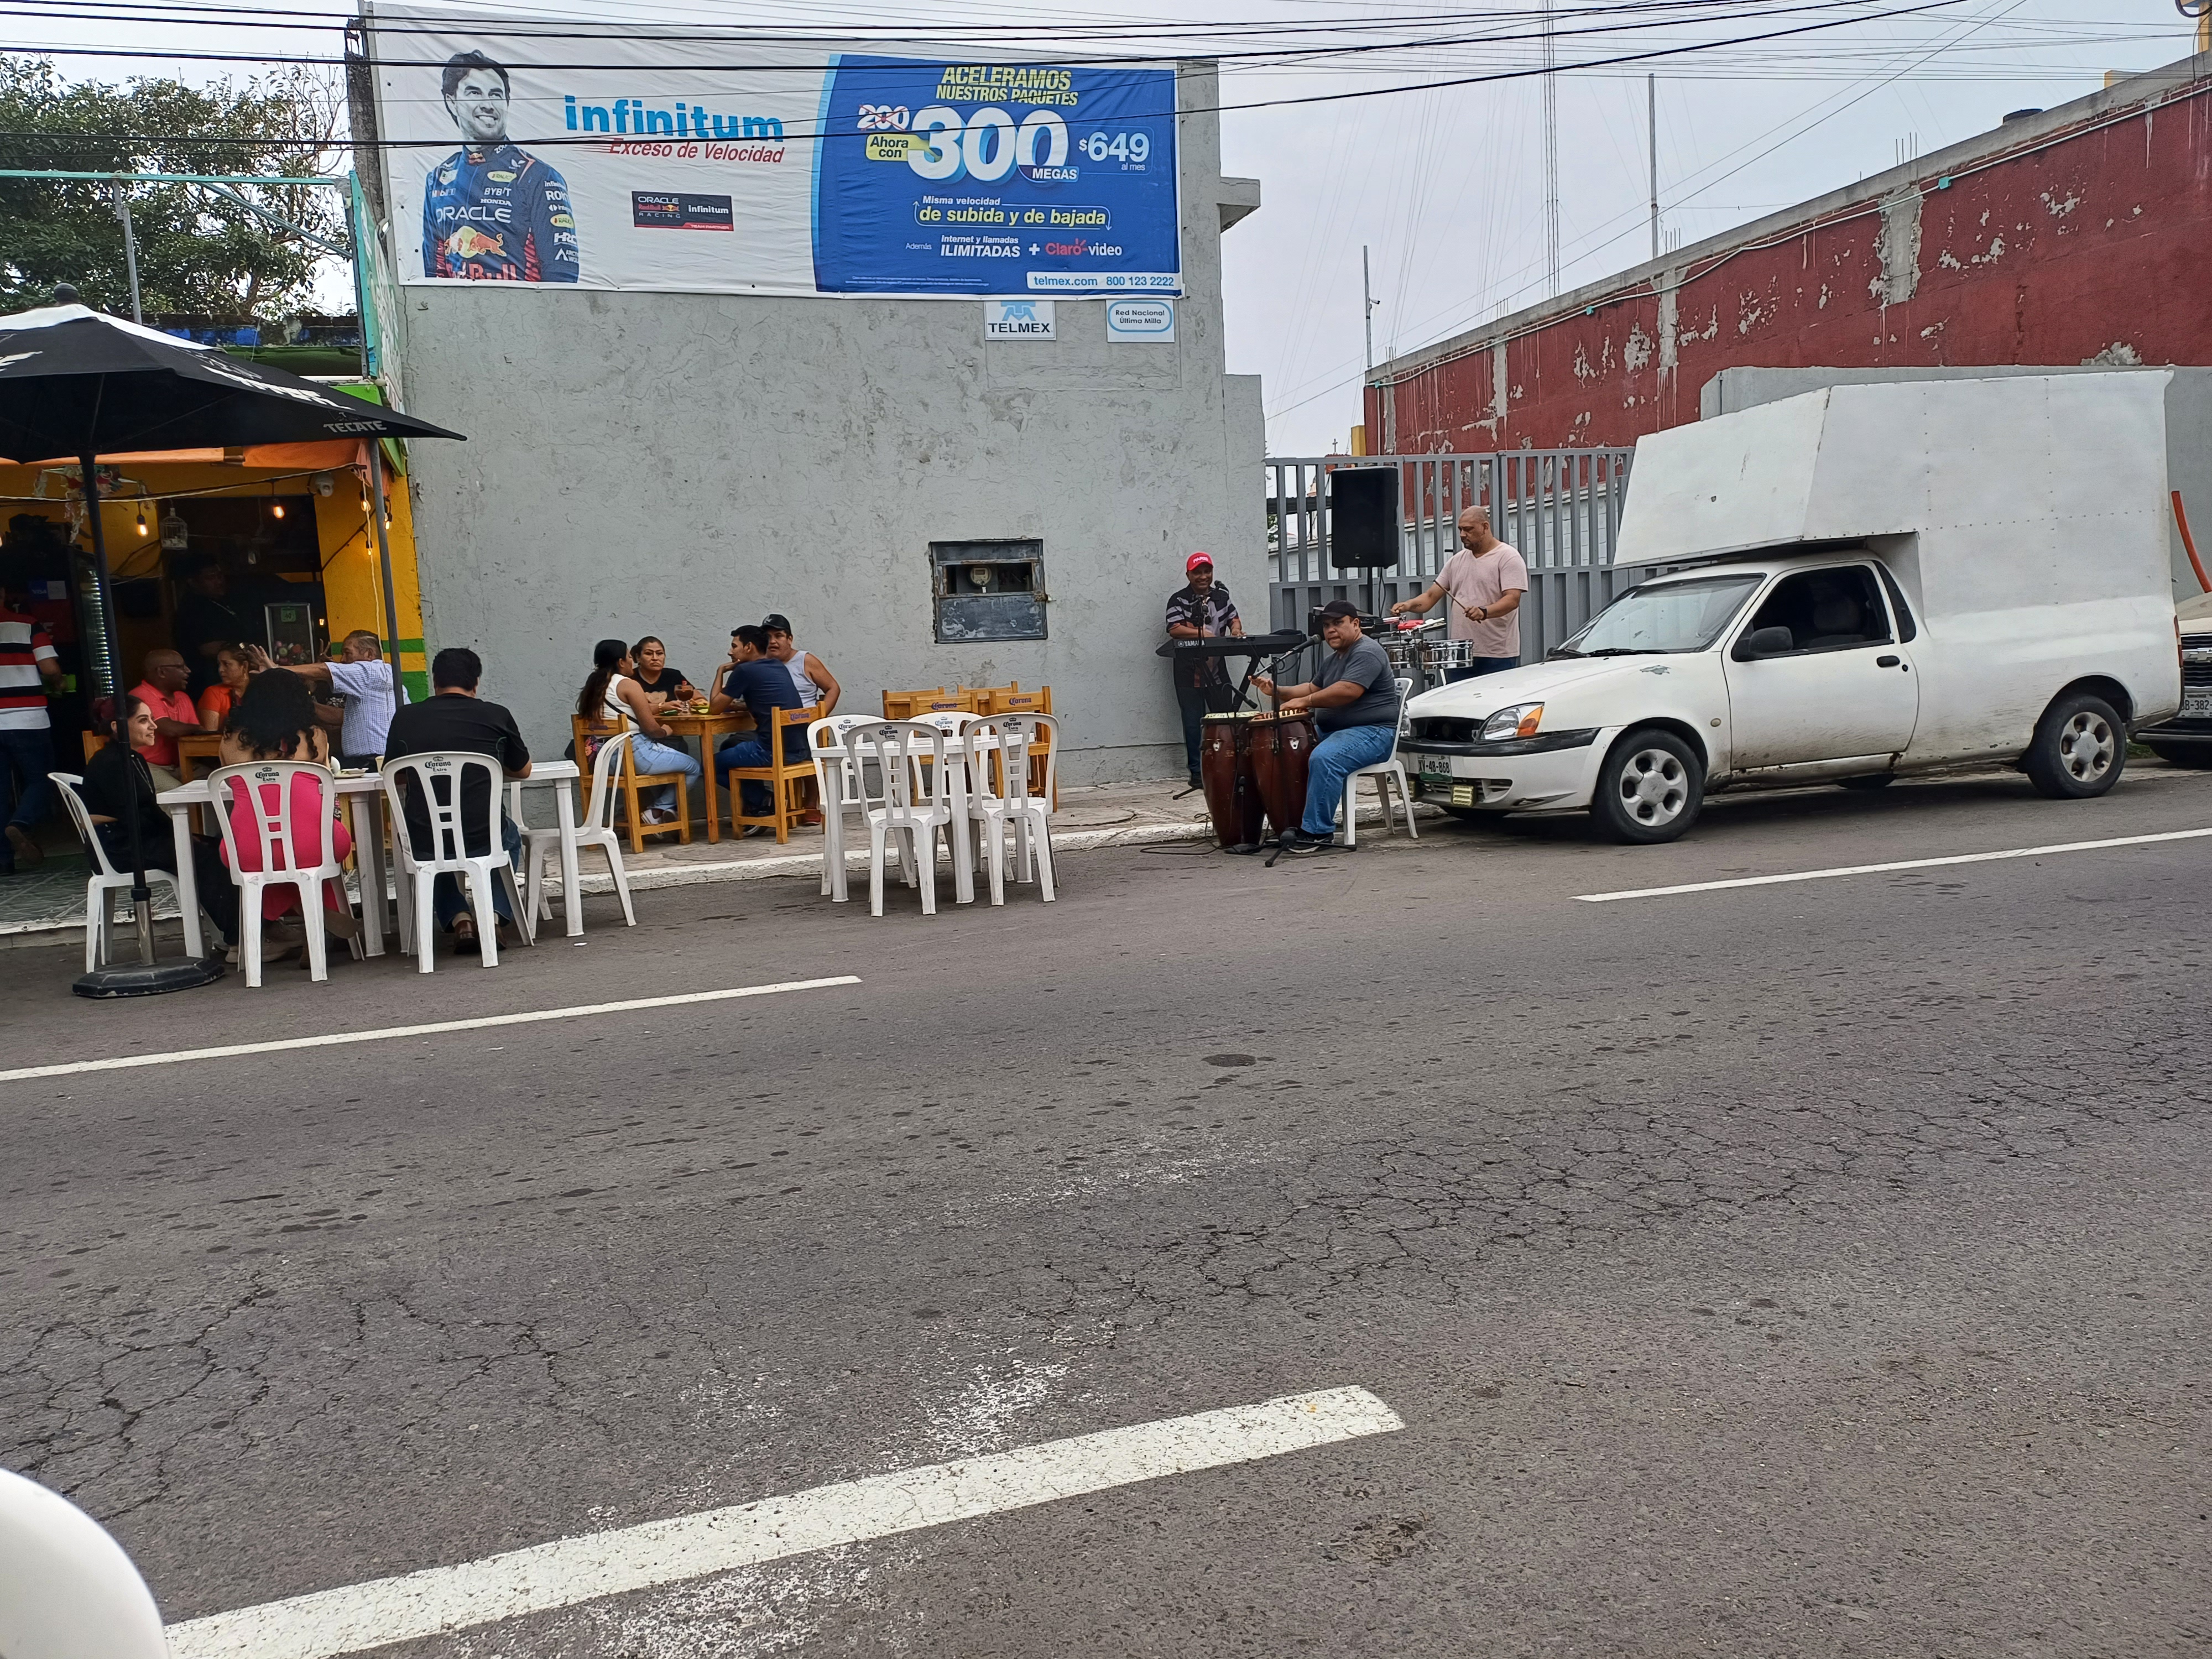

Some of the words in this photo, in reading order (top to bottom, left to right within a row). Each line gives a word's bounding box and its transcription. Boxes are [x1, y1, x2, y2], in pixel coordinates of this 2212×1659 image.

[941, 66, 1072, 91] ACELERAMOS
[936, 85, 1008, 102] NUESTROS
[1011, 89, 1078, 106] PAQUETES
[564, 95, 784, 142] infinitum
[857, 104, 910, 132] 200
[869, 135, 909, 149] Ahora
[907, 104, 1070, 181] 300
[1032, 168, 1078, 180] MEGAS
[1078, 131, 1150, 163] $649
[609, 138, 673, 157] Exceso
[677, 142, 698, 159] de
[705, 143, 785, 163] Velocidad
[878, 148, 902, 158] con
[1121, 163, 1128, 171] al
[484, 187, 512, 197] BYBIT
[480, 199, 513, 207] HONDA
[638, 196, 680, 205] ORACLE
[922, 195, 953, 205] Misma
[956, 196, 1001, 206] velocidad
[688, 205, 729, 214] Infinitum
[919, 206, 941, 221] de
[947, 207, 1004, 223] subida
[1009, 210, 1020, 226] y
[1024, 208, 1045, 223] de
[1050, 209, 1106, 227] bajada
[983, 236, 1019, 244] llamadas
[905, 242, 932, 251] Además
[941, 244, 1021, 258] ILIMITADAS
[1045, 240, 1084, 256] Claro
[1088, 242, 1123, 256] video
[1034, 275, 1098, 286] telmex.com
[1106, 276, 1125, 286] 800
[1129, 276, 1147, 286] 123
[1150, 276, 1175, 287] 2222
[988, 323, 1051, 333] TELMEX
[323, 420, 387, 432] TECATE
[931, 702, 957, 711] Corona
[1009, 697, 1032, 706] Corona
[424, 761, 451, 769] Corona
